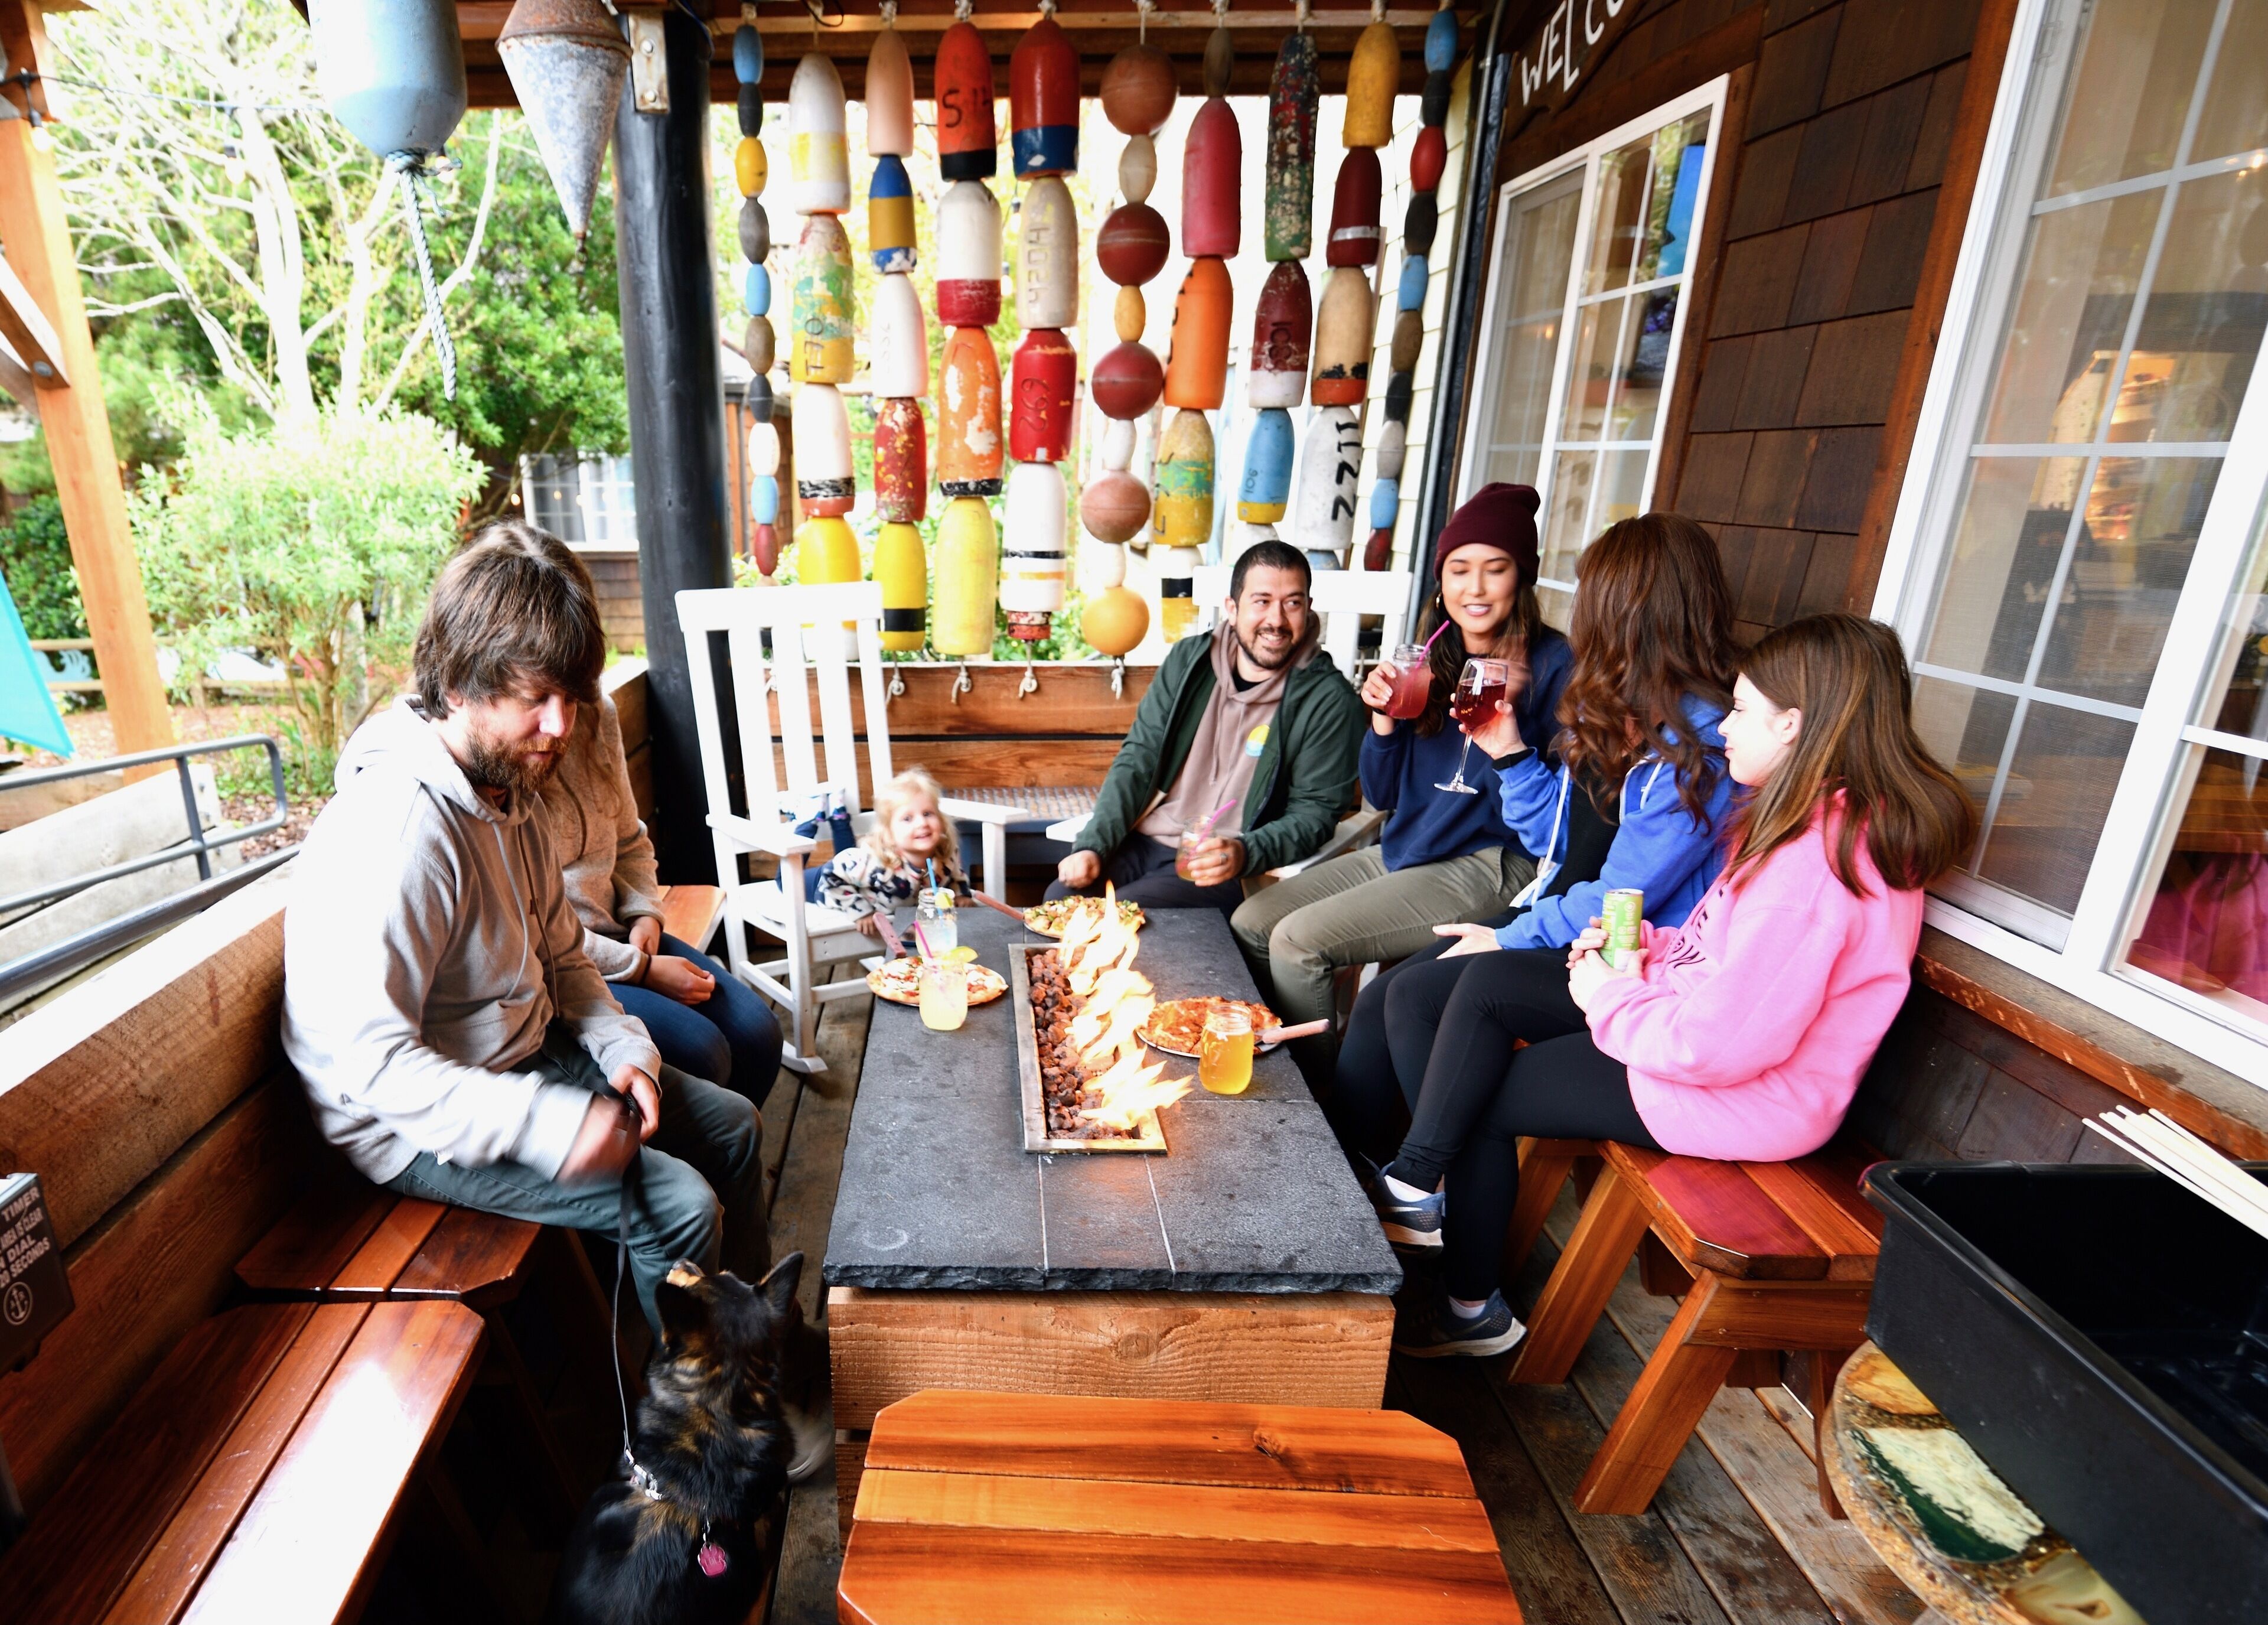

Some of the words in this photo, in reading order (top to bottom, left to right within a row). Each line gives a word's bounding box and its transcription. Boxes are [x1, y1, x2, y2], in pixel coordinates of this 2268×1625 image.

[1521, 0, 1625, 106] WELC
[1, 1186, 40, 1222] TIMER
[22, 1207, 44, 1232] CLEAR
[6, 1234, 36, 1262] DIAL
[9, 1236, 51, 1278] SECONDS
